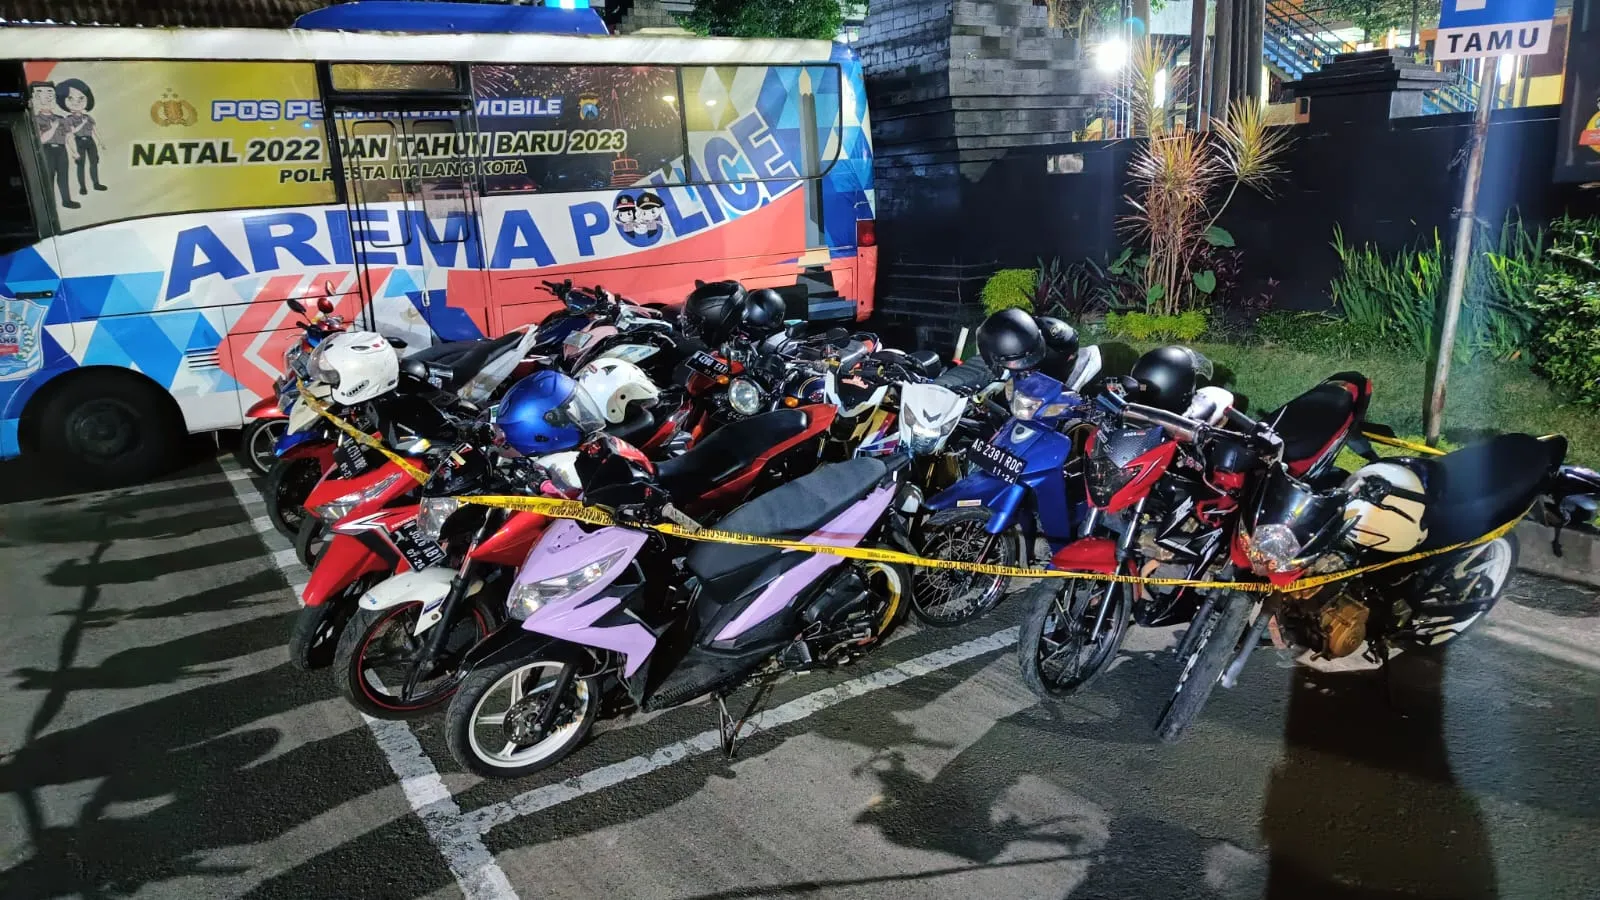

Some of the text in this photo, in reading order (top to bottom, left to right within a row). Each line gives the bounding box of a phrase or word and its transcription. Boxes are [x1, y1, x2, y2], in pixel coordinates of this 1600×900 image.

[1447, 27, 1540, 54] TAMU
[212, 100, 280, 121] POS
[467, 99, 561, 117] MOBILE
[132, 142, 238, 166] NATAL
[247, 139, 320, 162] 2022
[399, 135, 488, 158] TAHUN
[495, 132, 564, 154] BARU
[569, 131, 626, 152] 2023
[279, 161, 526, 184] POLRESTA MALANG KOTA
[568, 110, 803, 256] POLICE
[165, 208, 557, 301] AREMA
[982, 444, 1006, 464] 2381
[1004, 456, 1023, 473] RDC
[422, 545, 443, 562] ABY
